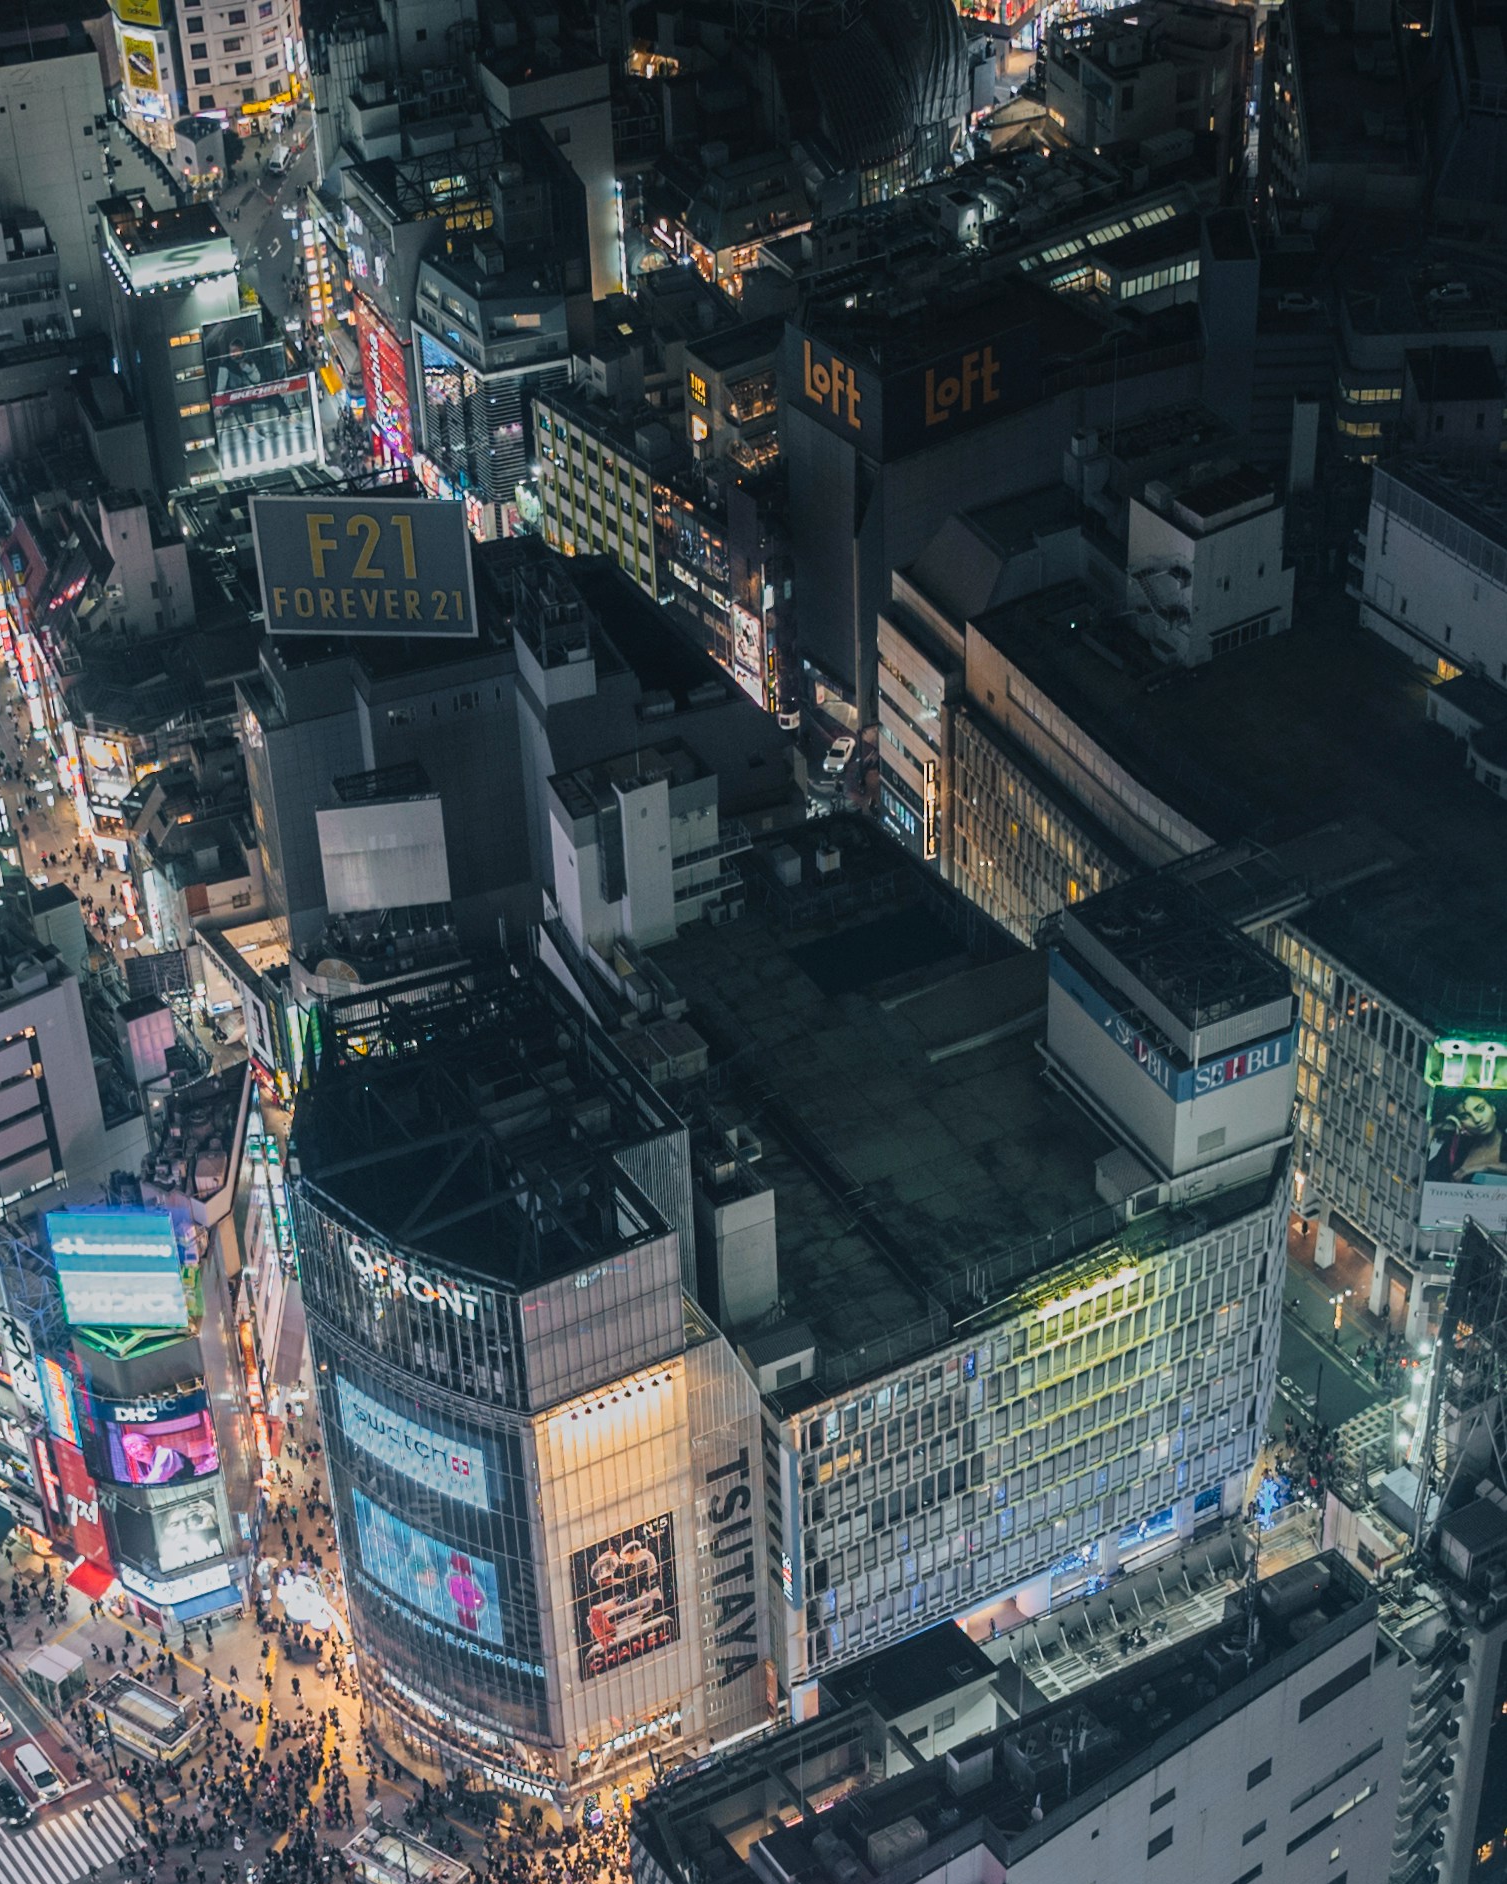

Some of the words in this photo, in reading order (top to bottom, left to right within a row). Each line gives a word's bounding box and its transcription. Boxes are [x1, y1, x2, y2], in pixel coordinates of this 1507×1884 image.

[230, 381, 290, 401] SKECHERS
[306, 513, 418, 579] F21
[273, 587, 424, 621] FOREVER
[431, 590, 465, 621] 21
[1114, 1018, 1171, 1091] SEIBU
[1195, 1041, 1282, 1094] SEIBU
[348, 1244, 479, 1321] QFRONT
[114, 1407, 158, 1422] DHC
[353, 1402, 448, 1468] swatch
[705, 1446, 758, 1688] TSUTAYA
[589, 1629, 670, 1671] CHANEL
[601, 1710, 682, 1758] TSUTAYA
[483, 1766, 554, 1801] TSUTAYA
